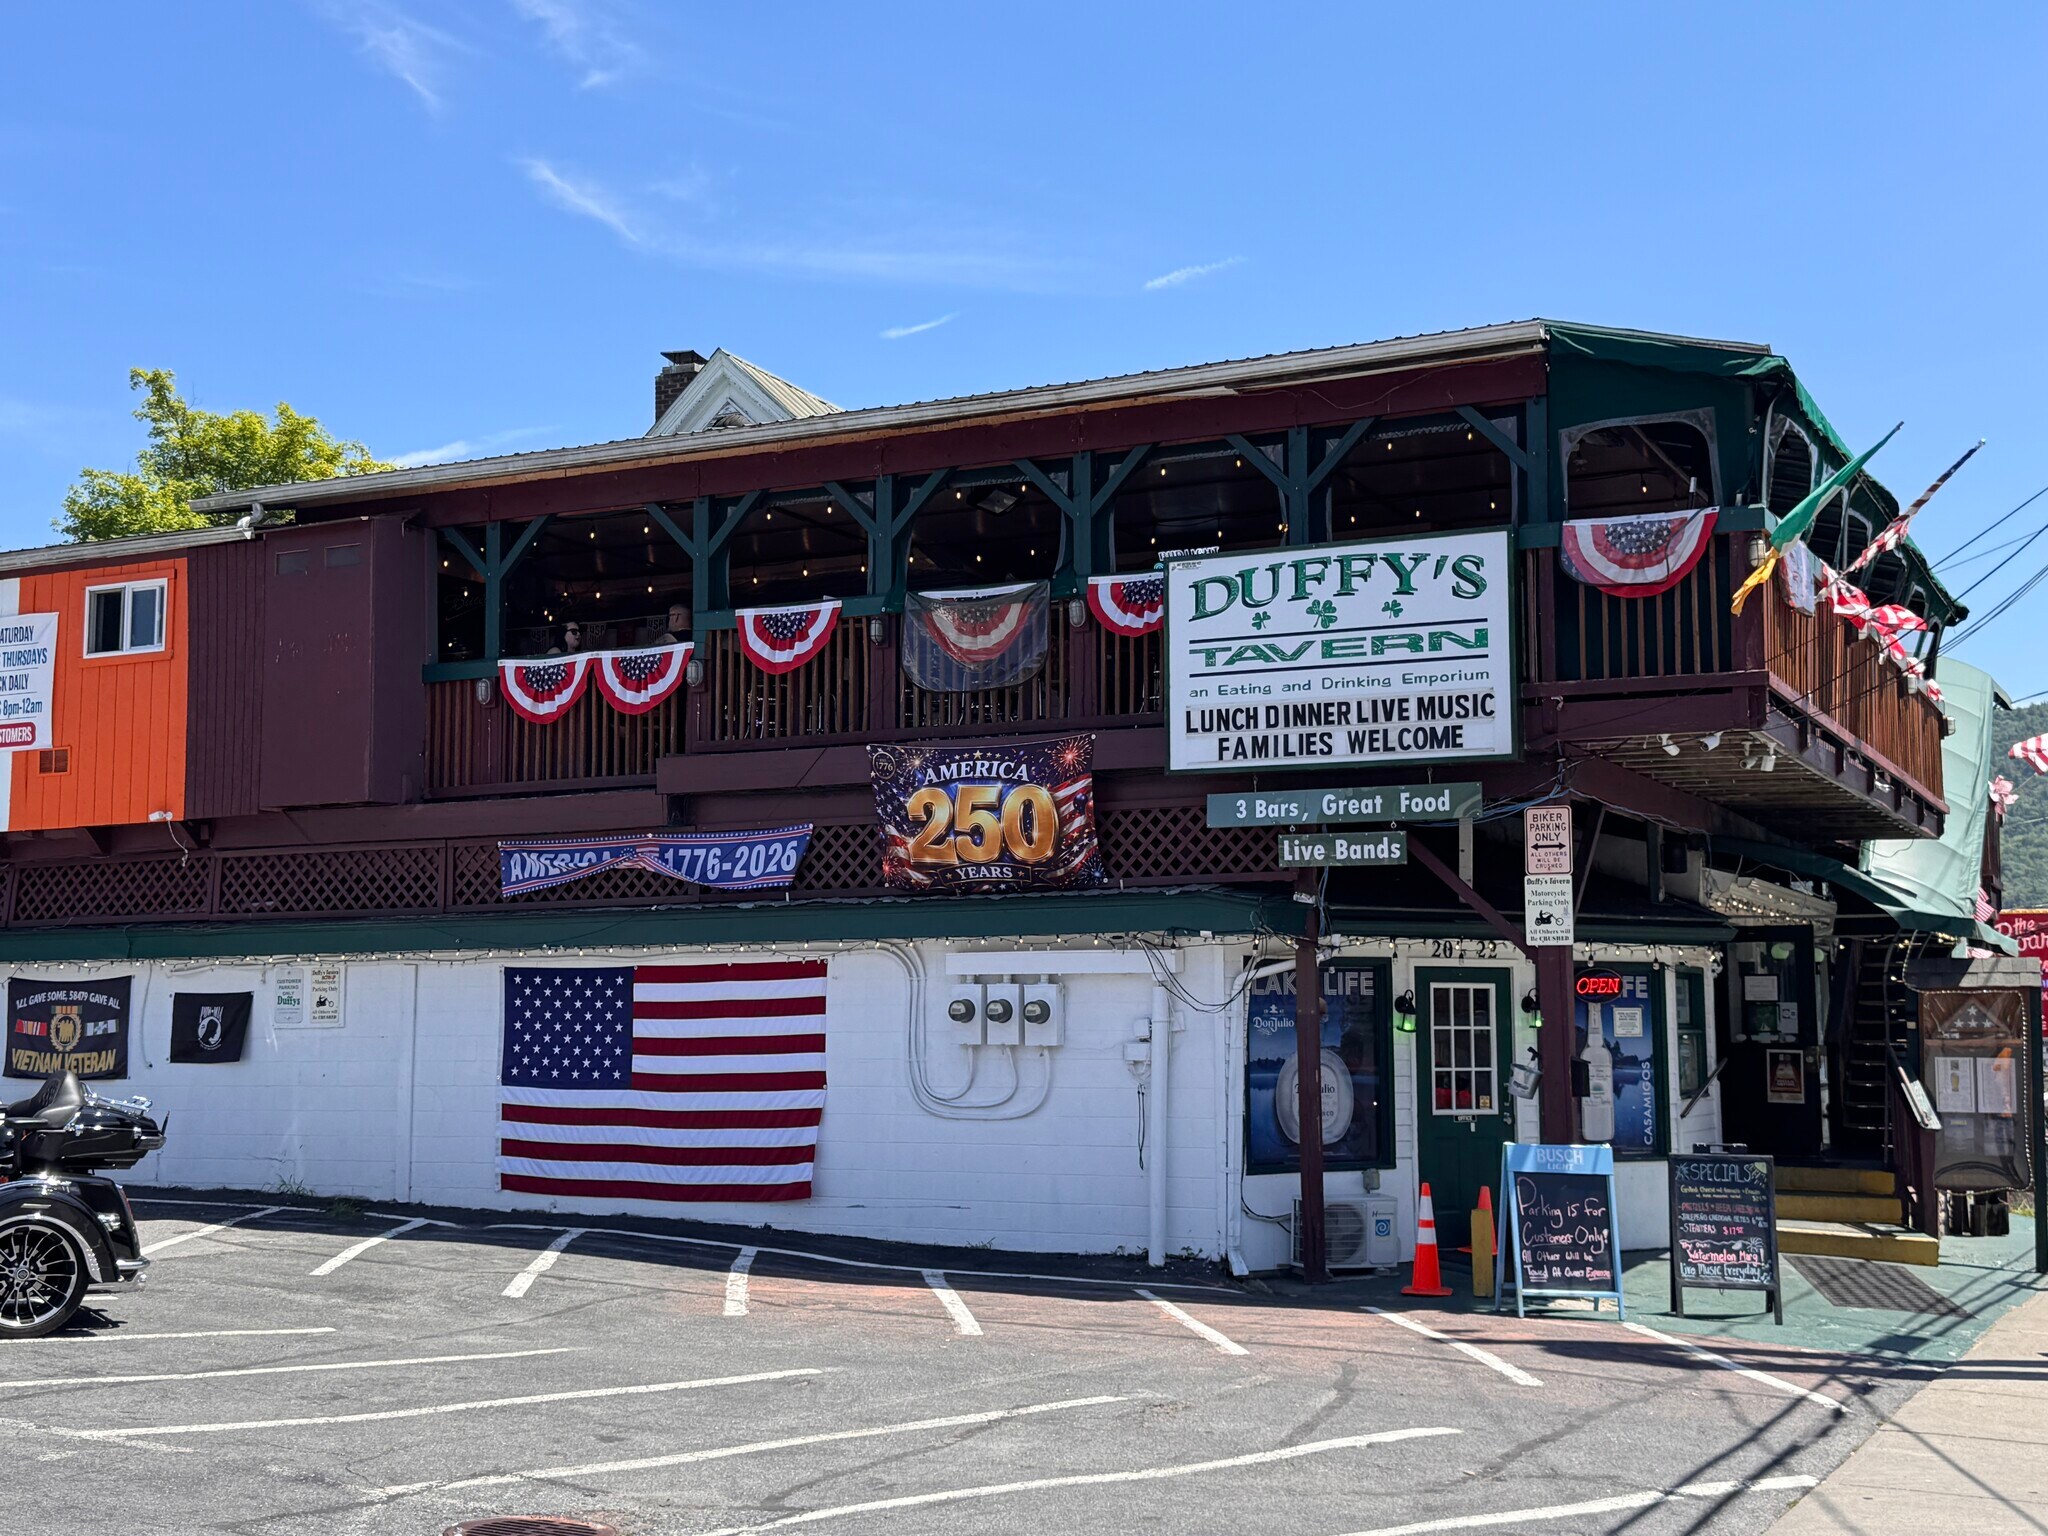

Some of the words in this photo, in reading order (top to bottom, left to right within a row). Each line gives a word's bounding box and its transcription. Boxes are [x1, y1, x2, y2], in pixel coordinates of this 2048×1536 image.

[1188, 552, 1488, 623] DUFFY'S
[0, 625, 35, 643] ATURDAY
[2, 647, 47, 668] THURSDAYS
[1189, 628, 1489, 667] TAVERN
[8, 673, 29, 691] DAILY
[1189, 689, 1208, 697] an
[1218, 683, 1272, 695] Eating
[1281, 679, 1312, 692] and
[1321, 675, 1391, 691] Drinking
[1401, 669, 1490, 686] Emporium
[3, 697, 42, 717] 8pm-12am
[1186, 706, 1258, 733] LUNCH
[1265, 701, 1351, 729] DINNER
[1356, 698, 1410, 724] LIVE
[1416, 693, 1496, 722] MUSIC
[1218, 732, 1333, 761] FAMILIES
[1347, 725, 1464, 754] WELCOME
[924, 760, 1029, 785] AMERICA
[1236, 800, 1247, 818] 3
[1255, 800, 1309, 822] Bars,
[1322, 794, 1382, 816] Great
[1400, 789, 1450, 812] Food
[1532, 813, 1562, 822] BIKER
[907, 784, 1060, 864] 250
[1530, 822, 1566, 832] PARKING
[1283, 840, 1325, 861] Live
[1335, 837, 1401, 860] Bands
[1535, 832, 1561, 842] ONLY
[664, 840, 798, 881] 1776-2026
[956, 866, 1013, 880] YEARS
[2013, 917, 2035, 936] the
[1431, 940, 1453, 958] 20
[1476, 941, 1497, 959] 22
[1251, 972, 1298, 996] LAK
[1324, 971, 1374, 995] LIFE
[1577, 977, 1620, 994] OPEN
[28, 992, 47, 1005] GAVE
[47, 990, 68, 1002] SOME,
[89, 992, 108, 1005] GAVE
[108, 997, 120, 1010] ALL
[12, 1048, 63, 1074] VIETNAM
[64, 1048, 117, 1074] VETERAN
[1640, 1060, 1654, 1145] CASAMIGOS
[1537, 1149, 1584, 1165] BUSCH
[1690, 1163, 1751, 1182] SPECIALS
[1517, 1176, 1563, 1228] Parking
[1567, 1202, 1580, 1217] is
[1522, 1221, 1573, 1246] Customers
